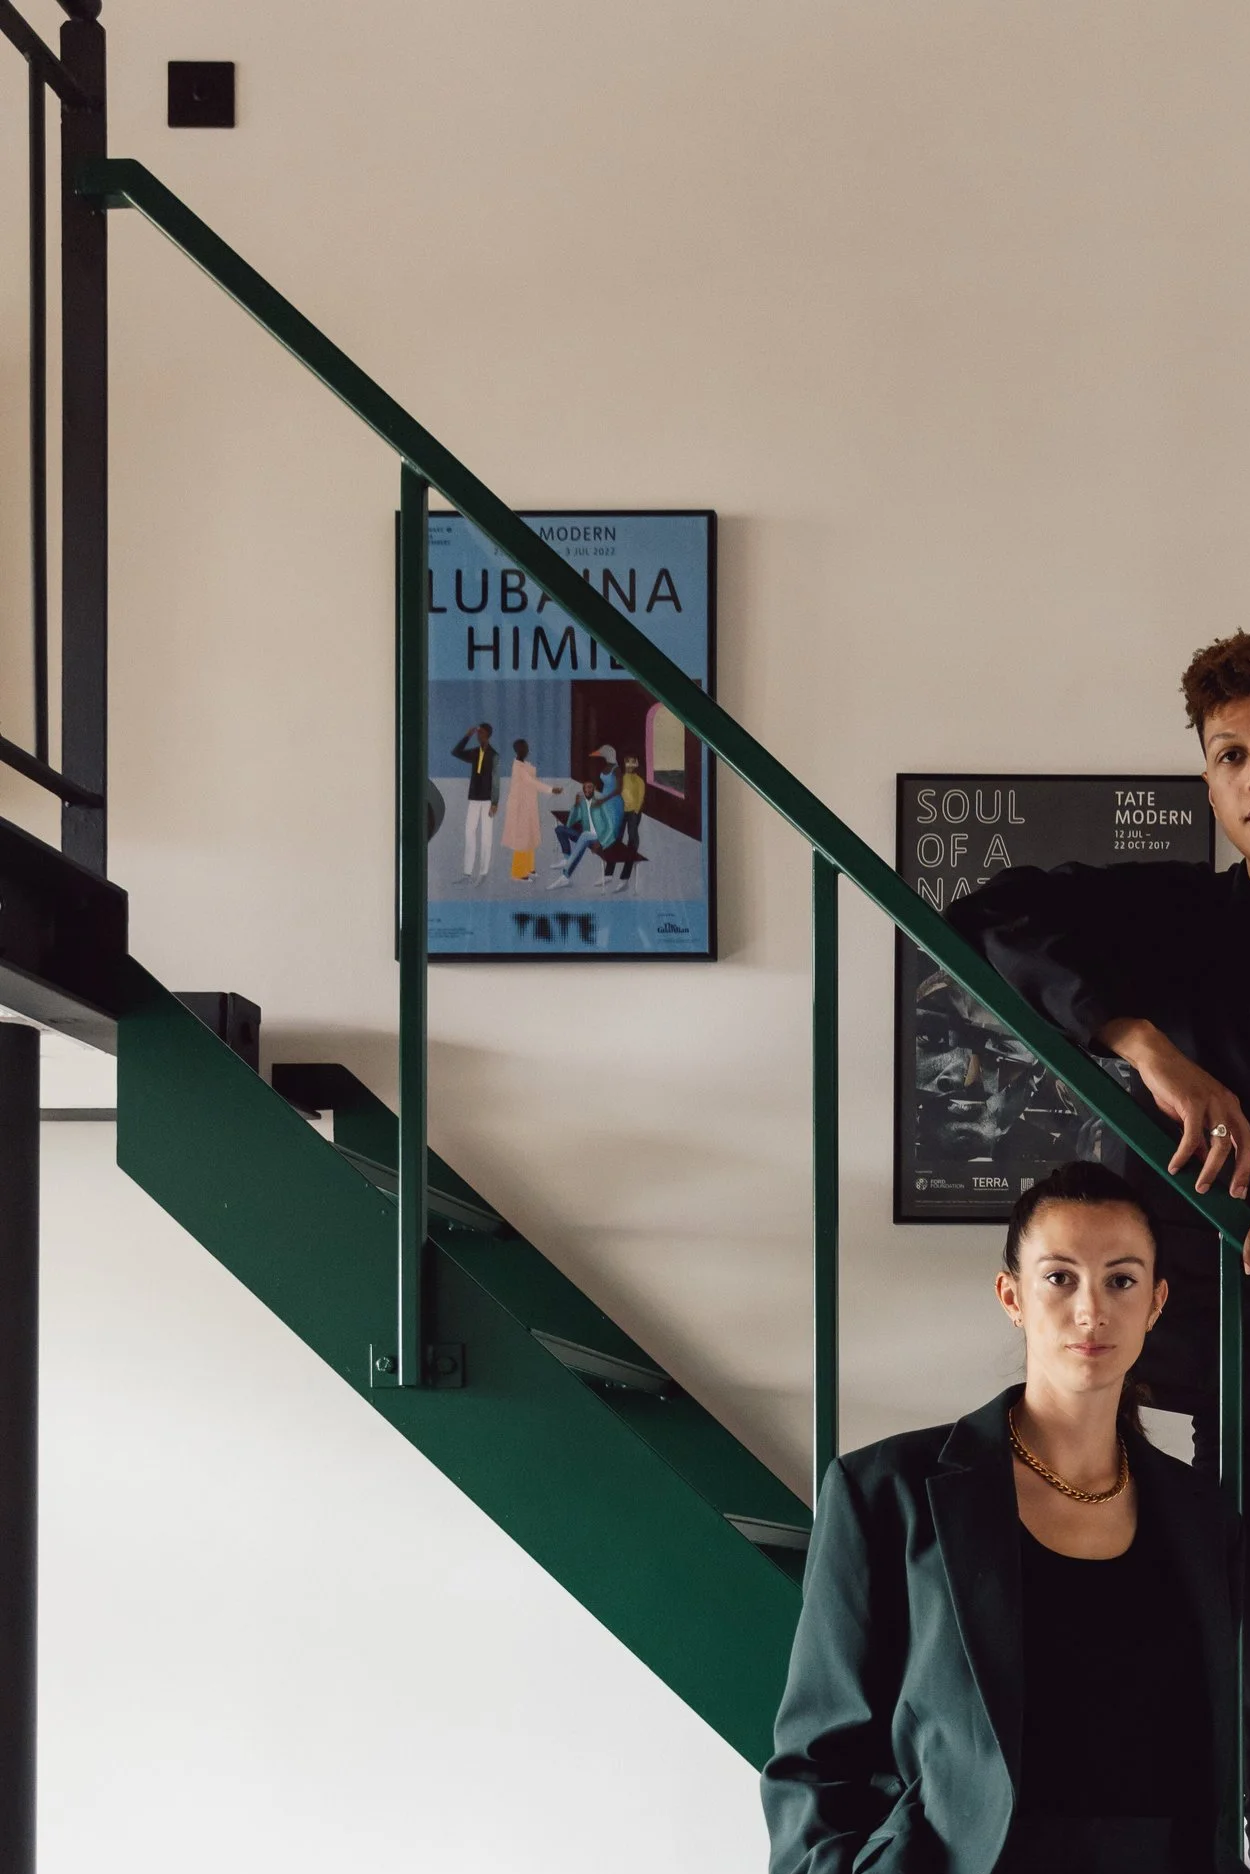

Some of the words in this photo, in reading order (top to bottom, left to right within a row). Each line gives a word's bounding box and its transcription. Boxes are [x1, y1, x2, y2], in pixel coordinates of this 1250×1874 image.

[539, 526, 616, 542] MODERN
[574, 547, 590, 556] JUL
[1115, 791, 1156, 807] TATE
[917, 789, 1026, 825] SOUL
[1115, 810, 1192, 825] MODERN
[1115, 830, 1125, 839] 12
[1127, 830, 1143, 839] JUL
[917, 833, 969, 868] OF
[983, 833, 1012, 868] A
[1114, 841, 1126, 850] 22
[1127, 841, 1146, 850] OCT
[1149, 841, 1171, 850] 2017
[972, 1177, 1009, 1188] TERRA
